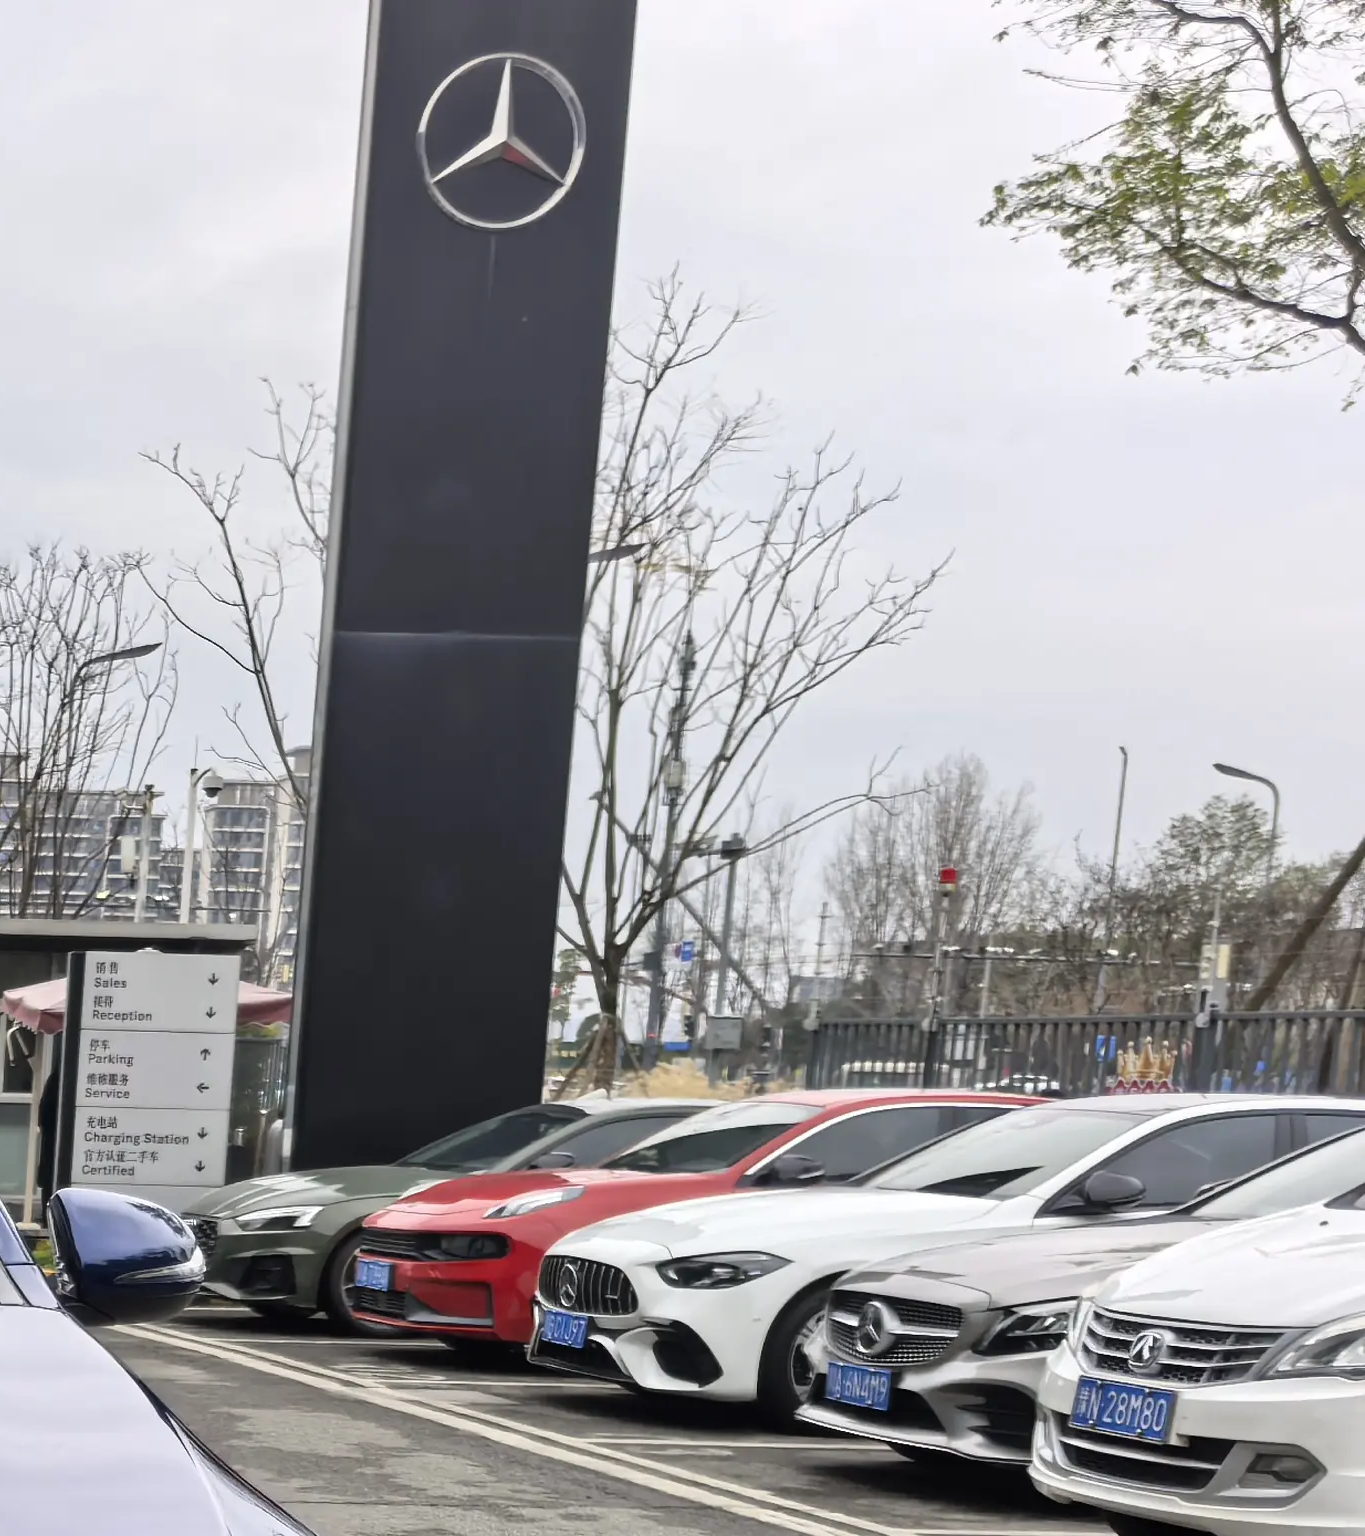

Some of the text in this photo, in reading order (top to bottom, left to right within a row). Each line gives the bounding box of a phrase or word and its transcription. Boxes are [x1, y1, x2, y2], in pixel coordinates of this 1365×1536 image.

[94, 978, 127, 989] Sales
[92, 1010, 152, 1022] Reception
[89, 1039, 110, 1050] 停车
[88, 1054, 134, 1067] Parking
[86, 1073, 129, 1086] 维修服务
[85, 1088, 130, 1099] Service
[86, 1117, 118, 1129] 充电站
[84, 1132, 189, 1146] Charging Station
[84, 1150, 159, 1163] 官方认证二手车
[82, 1165, 135, 1176] Certified
